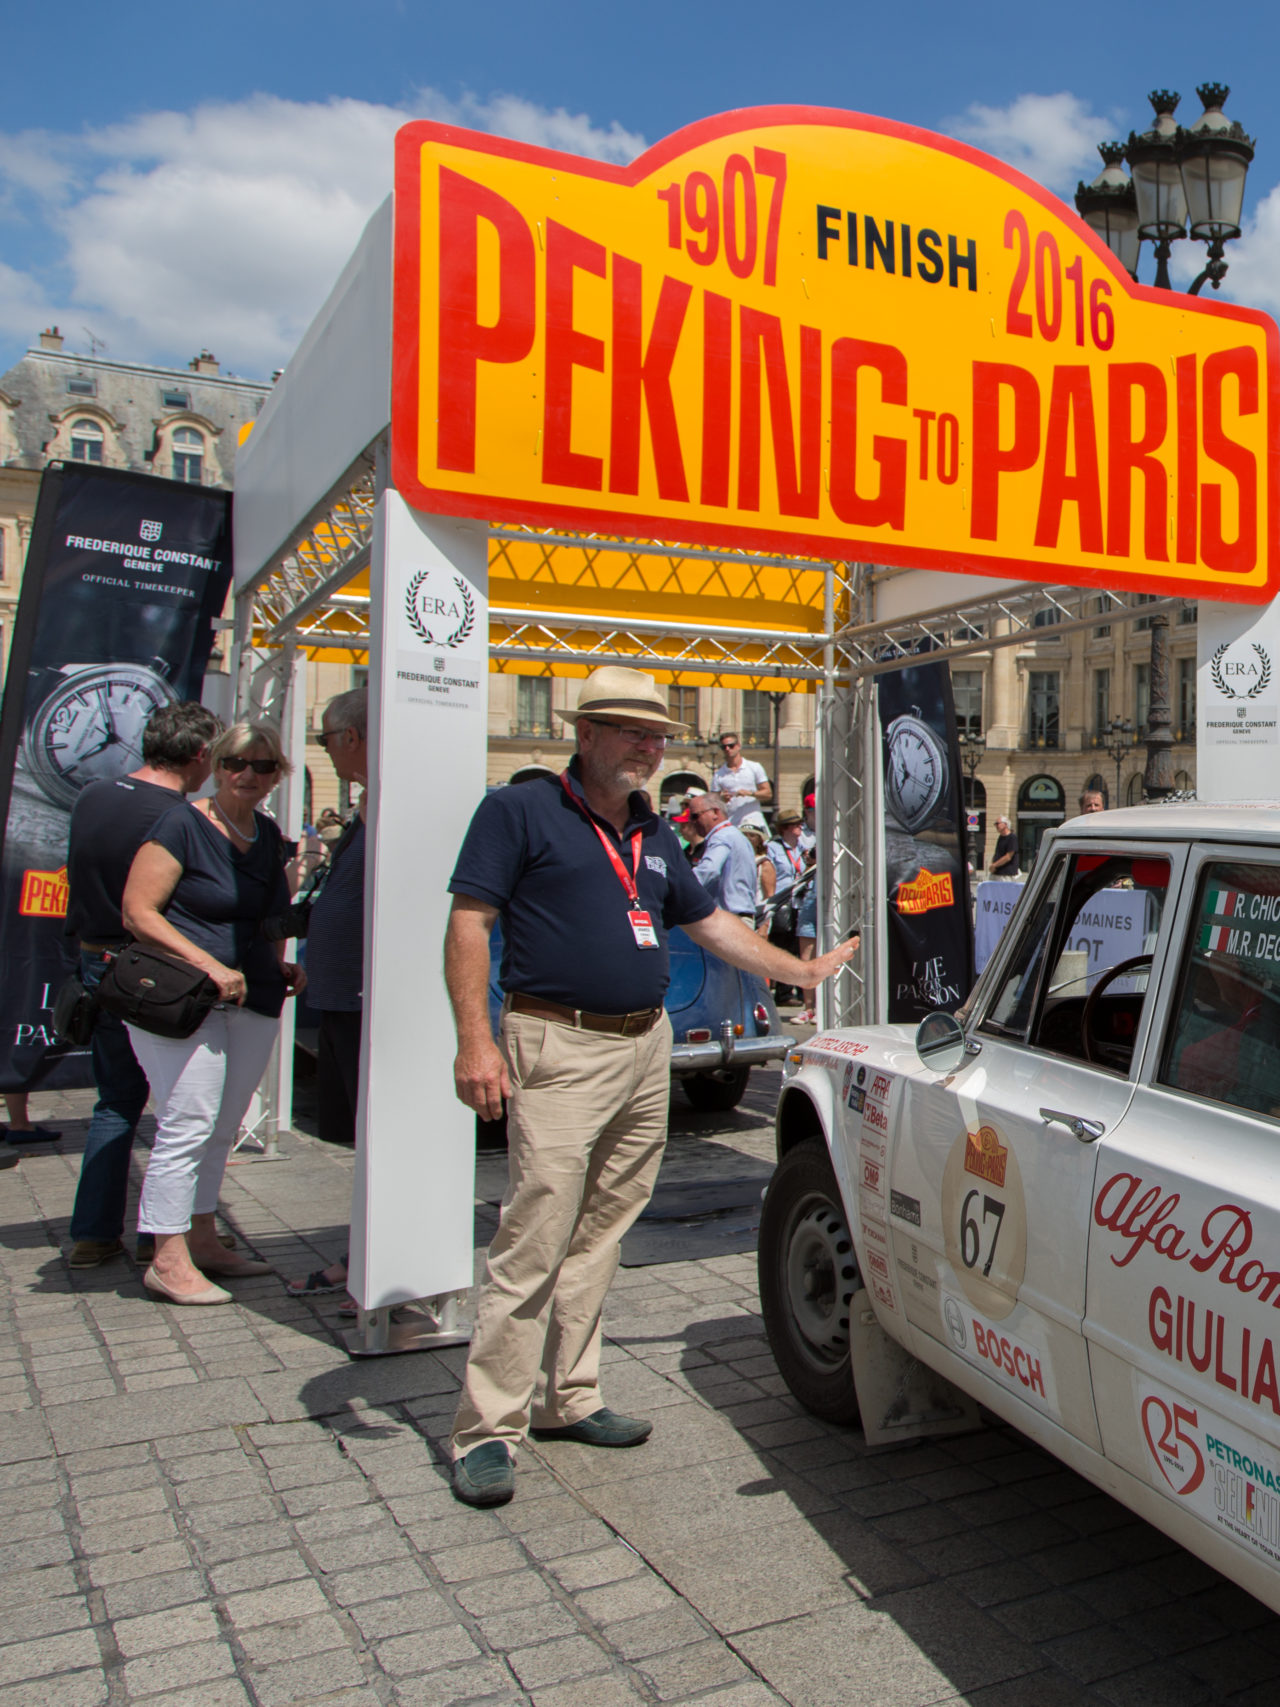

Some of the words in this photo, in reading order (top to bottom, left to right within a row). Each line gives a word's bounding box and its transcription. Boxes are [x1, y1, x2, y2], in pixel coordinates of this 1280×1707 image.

[657, 146, 787, 287] 1907
[816, 204, 979, 292] FINISH
[1002, 209, 1115, 352] 2016
[437, 164, 909, 532] PEKING
[912, 408, 960, 486] TO
[970, 345, 1260, 574] PARIS
[65, 534, 151, 560] FREDERIQUE
[154, 549, 222, 573] CONSTANT
[123, 558, 165, 574] GENEVE
[81, 573, 131, 589] OFFICIAL
[134, 580, 196, 599] TIMEKEEPER
[422, 595, 460, 619] ERA
[397, 671, 442, 685] FREDERIQUE
[443, 677, 480, 689] CONSTANT
[1225, 662, 1258, 676] ERA
[1206, 721, 1243, 729] FREDERIQUE
[1233, 892, 1247, 919] R.
[1226, 928, 1252, 957] M.R.
[960, 1189, 1006, 1278] 67
[1094, 1172, 1192, 1268] Alfa
[972, 1318, 1046, 1399] BOSCH
